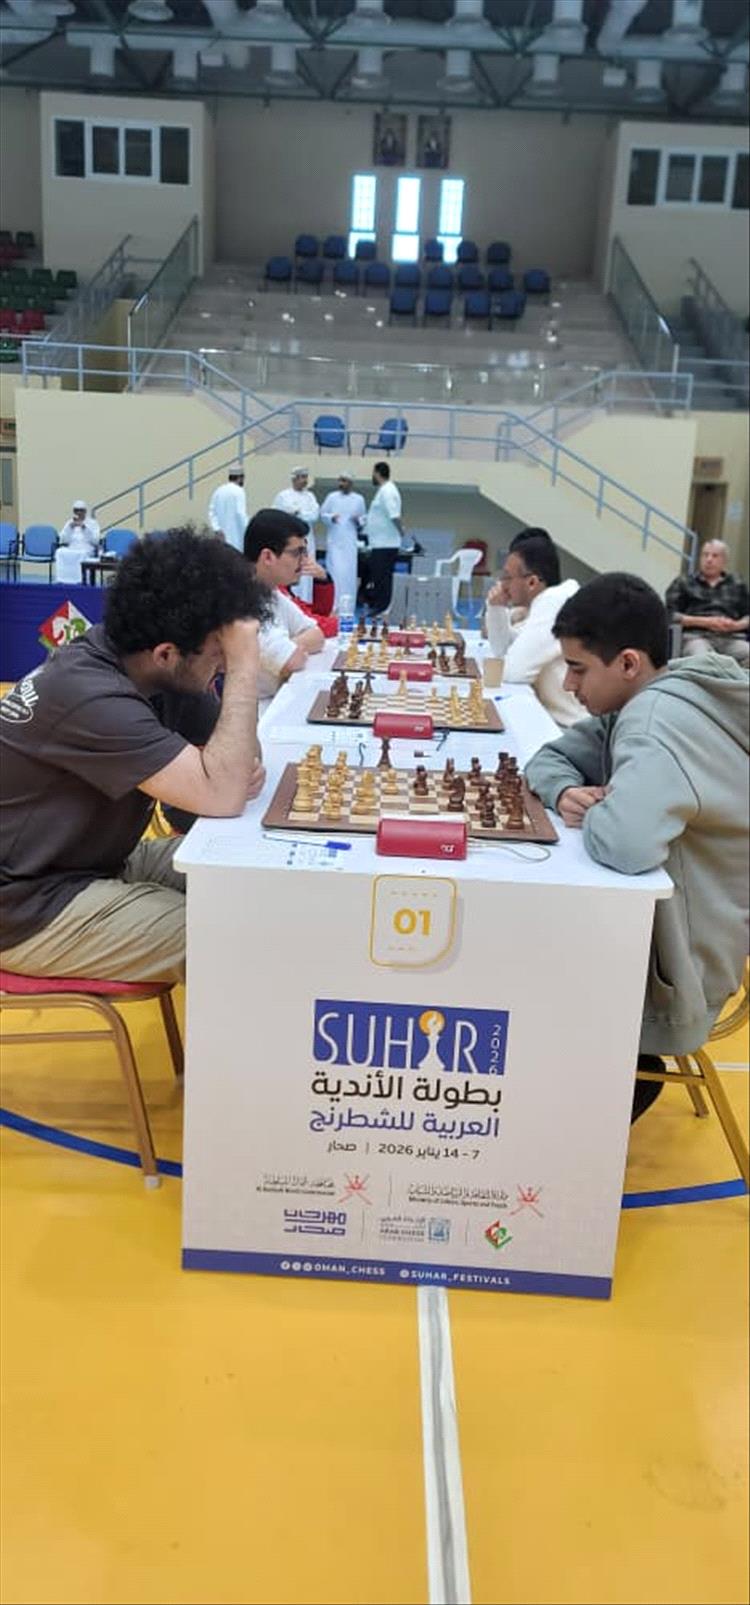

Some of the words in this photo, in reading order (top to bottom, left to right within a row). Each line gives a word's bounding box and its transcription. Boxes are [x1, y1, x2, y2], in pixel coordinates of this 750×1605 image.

[393, 908, 432, 936] 01
[489, 1024, 502, 1076] 2026
[311, 1070, 404, 1103] الأندية
[412, 1076, 502, 1113] بطولة
[309, 1106, 415, 1132] للشطرنج
[422, 1112, 500, 1140] العربية
[328, 1140, 358, 1154] صحار
[378, 1143, 414, 1155] 2026
[415, 1146, 441, 1160] يناير
[444, 1147, 459, 1159] 14
[472, 1149, 481, 1160] 7
